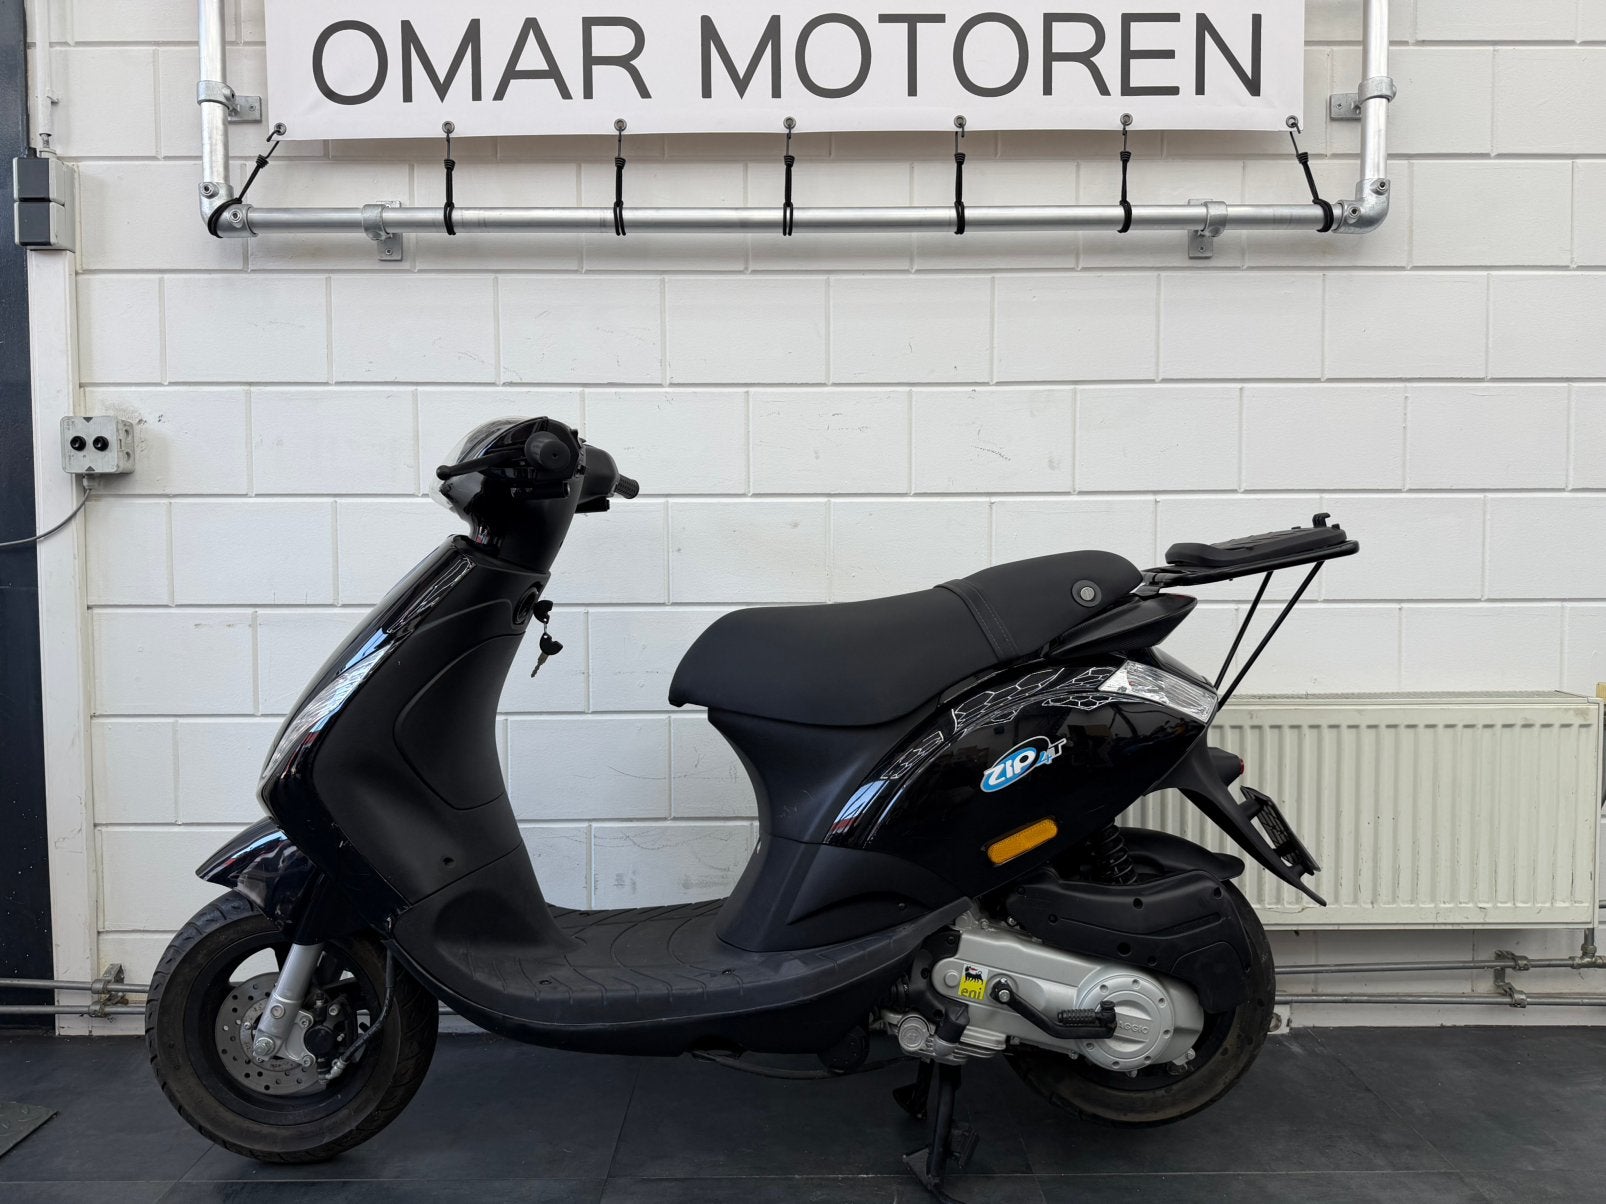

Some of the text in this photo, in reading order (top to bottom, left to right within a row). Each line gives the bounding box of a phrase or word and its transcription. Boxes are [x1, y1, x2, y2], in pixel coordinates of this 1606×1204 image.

[312, 11, 1262, 106] OMAR MOTOREN
[984, 749, 1037, 786] ZIP
[961, 987, 982, 1000] eni
[1116, 1020, 1150, 1034] AGGIO
